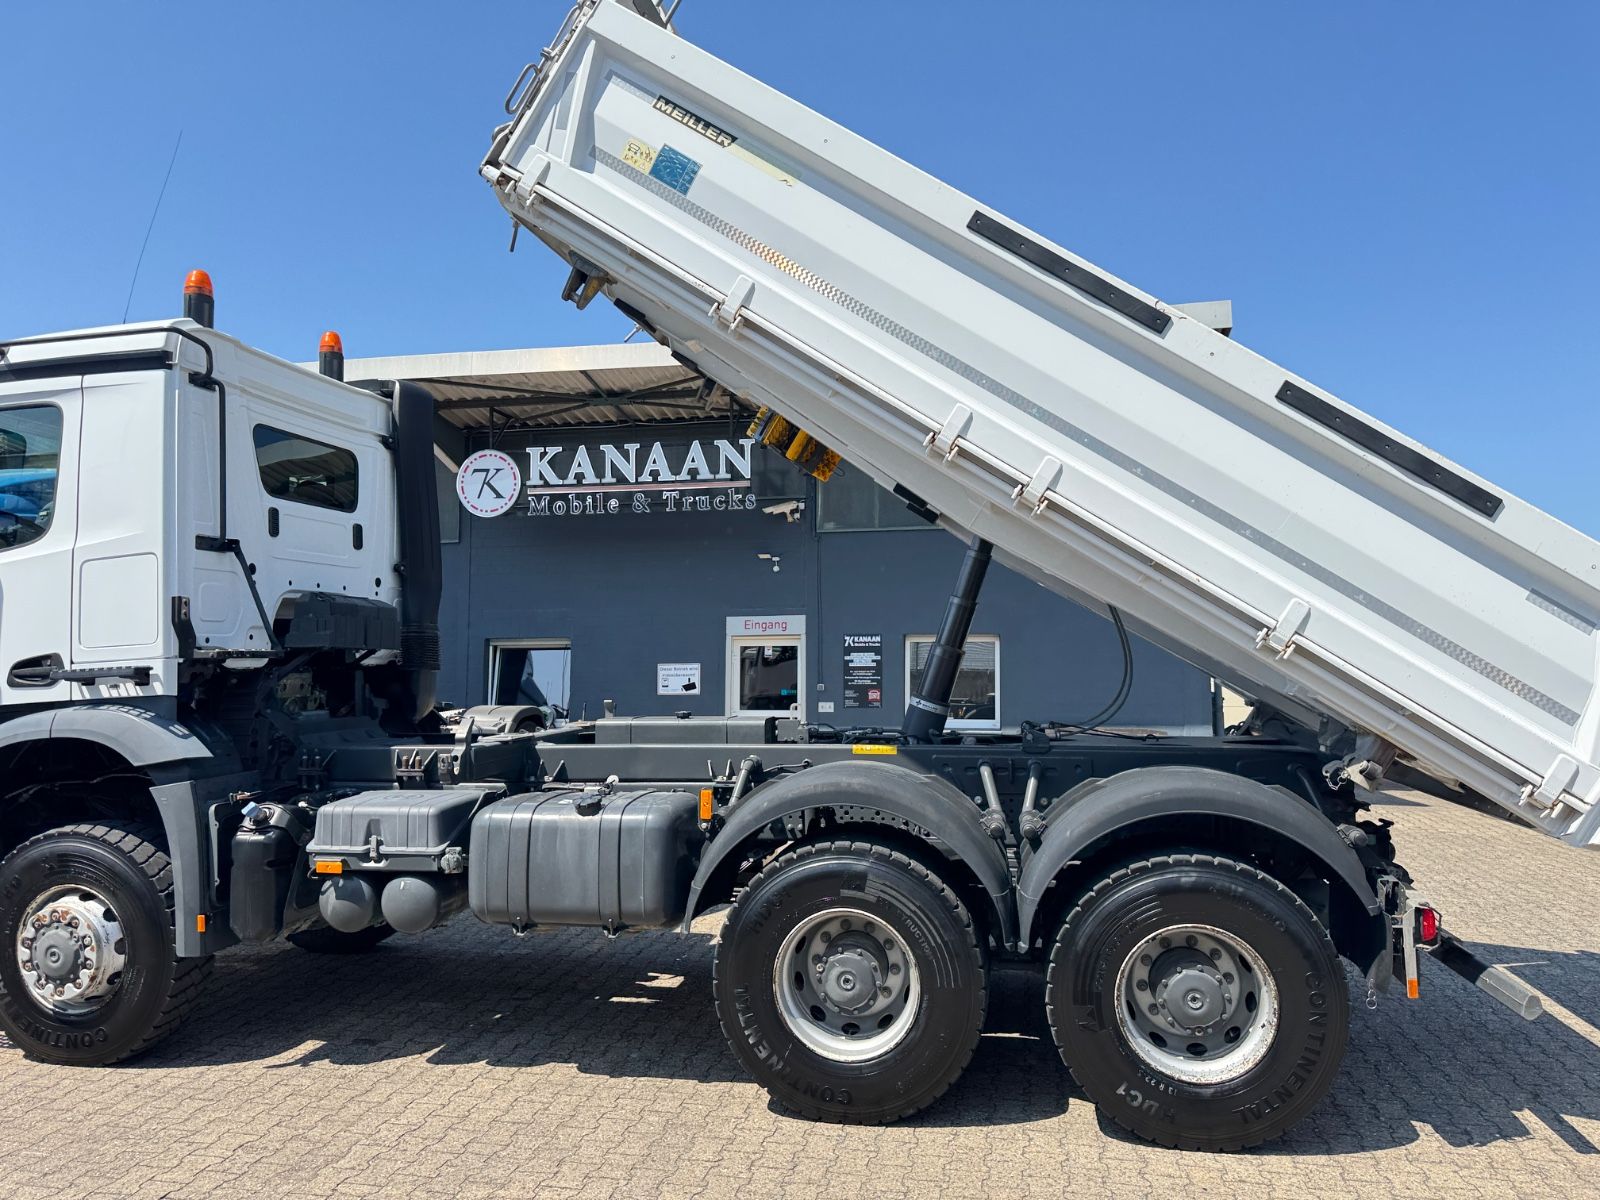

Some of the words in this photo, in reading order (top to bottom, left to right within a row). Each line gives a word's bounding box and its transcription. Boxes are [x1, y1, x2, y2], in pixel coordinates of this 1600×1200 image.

[655, 98, 733, 148] MEILLER
[525, 438, 756, 486] KANAAN
[527, 493, 619, 516] Mobile
[632, 493, 651, 513] &
[663, 488, 756, 512] Trucks
[744, 619, 788, 632] Eingang
